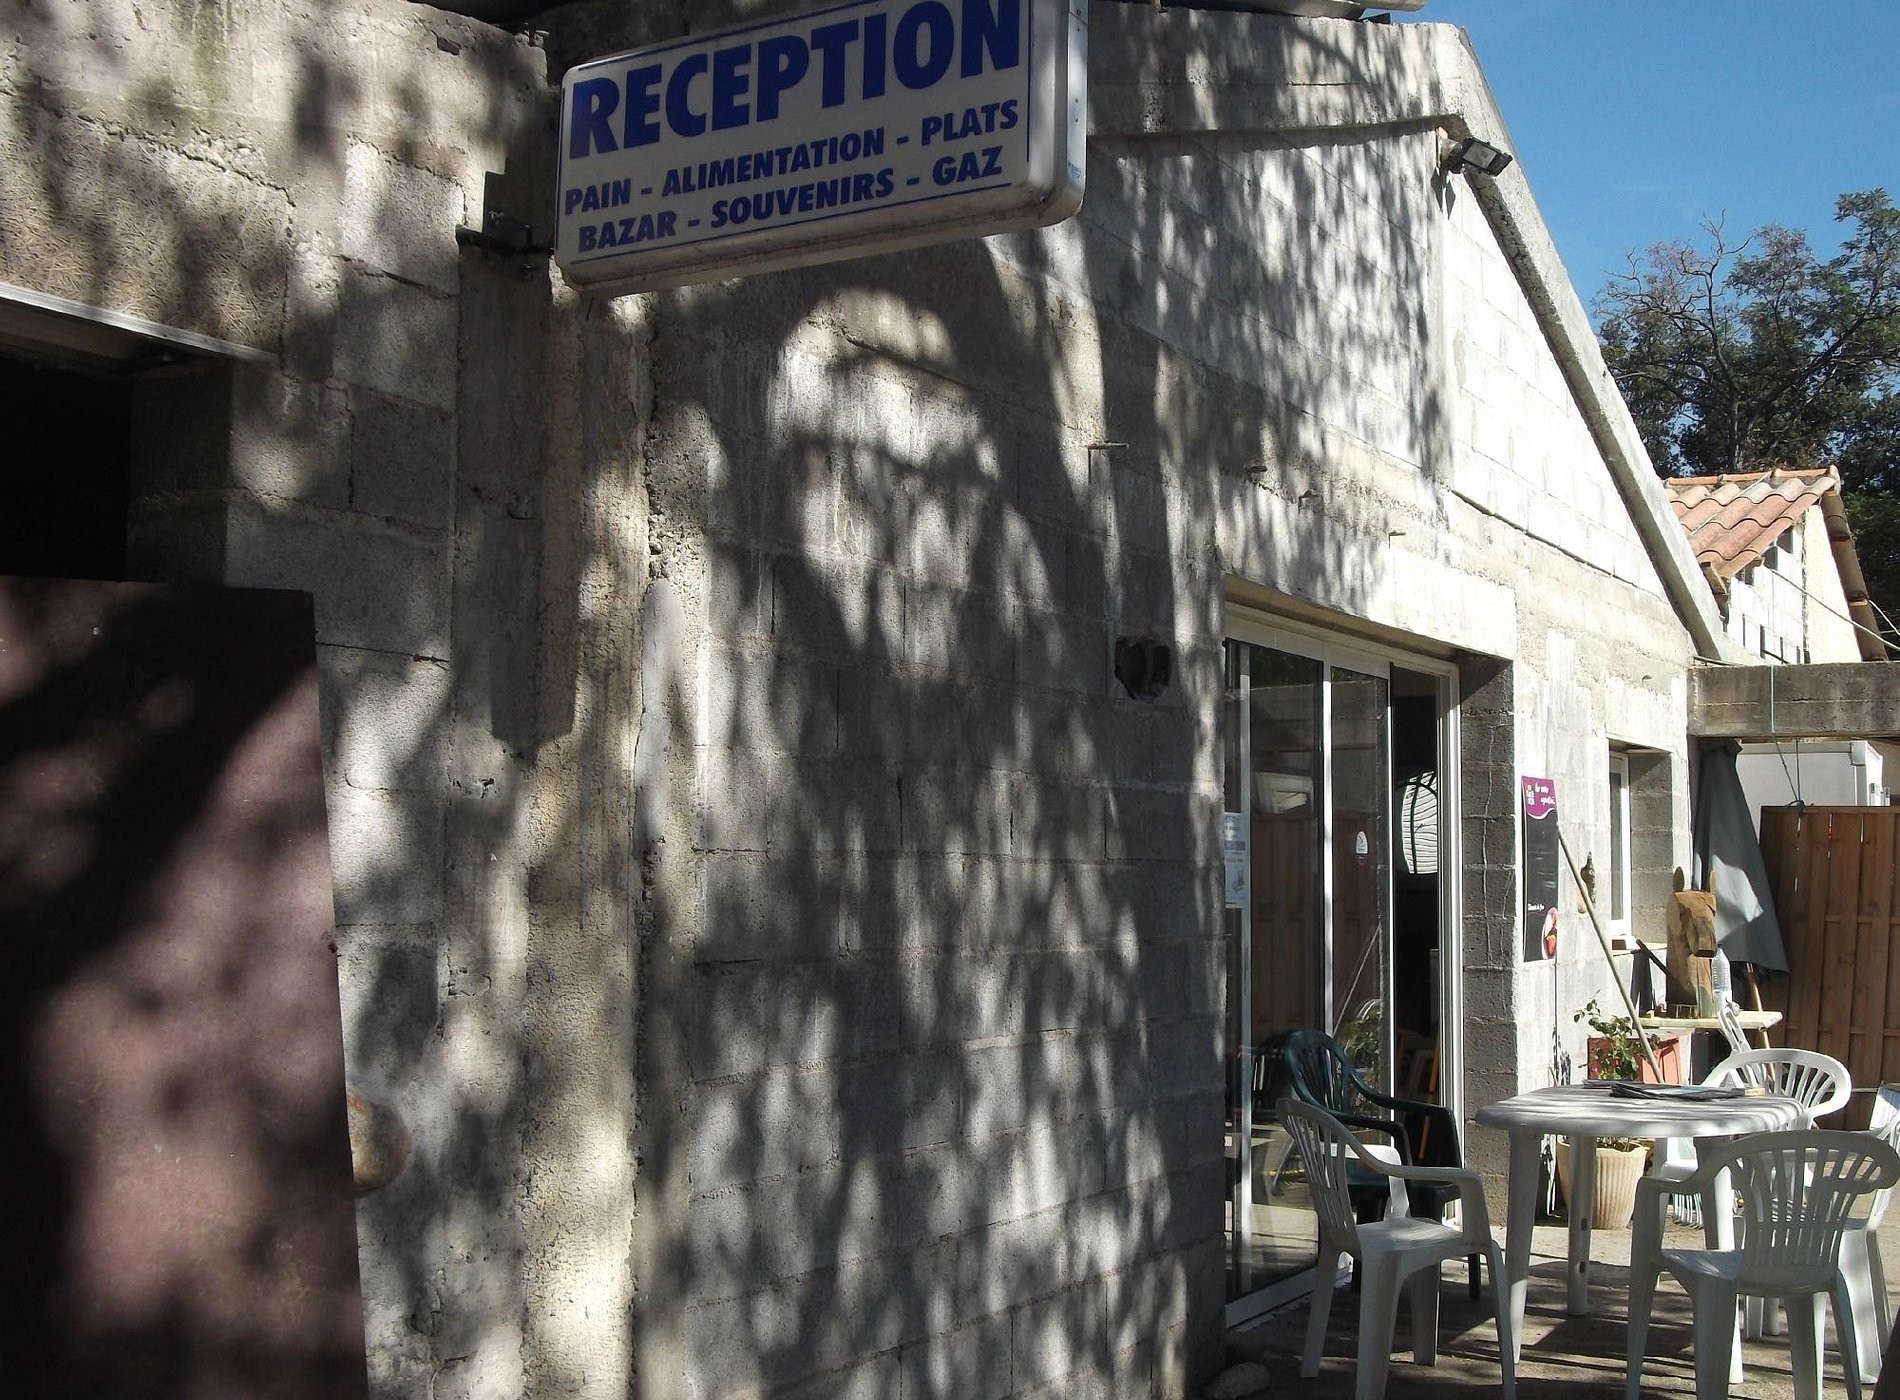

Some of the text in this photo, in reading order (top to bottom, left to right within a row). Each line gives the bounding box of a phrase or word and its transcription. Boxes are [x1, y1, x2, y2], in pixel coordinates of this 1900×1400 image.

[569, 0, 1020, 160] RECEPTION
[565, 178, 631, 215] PAIN
[661, 127, 885, 197] ALIMENTATION
[921, 99, 1018, 146] PLATS
[578, 210, 677, 253] BAZAR
[711, 168, 894, 228] SOUVENIRS
[932, 145, 1003, 186] GAZ
